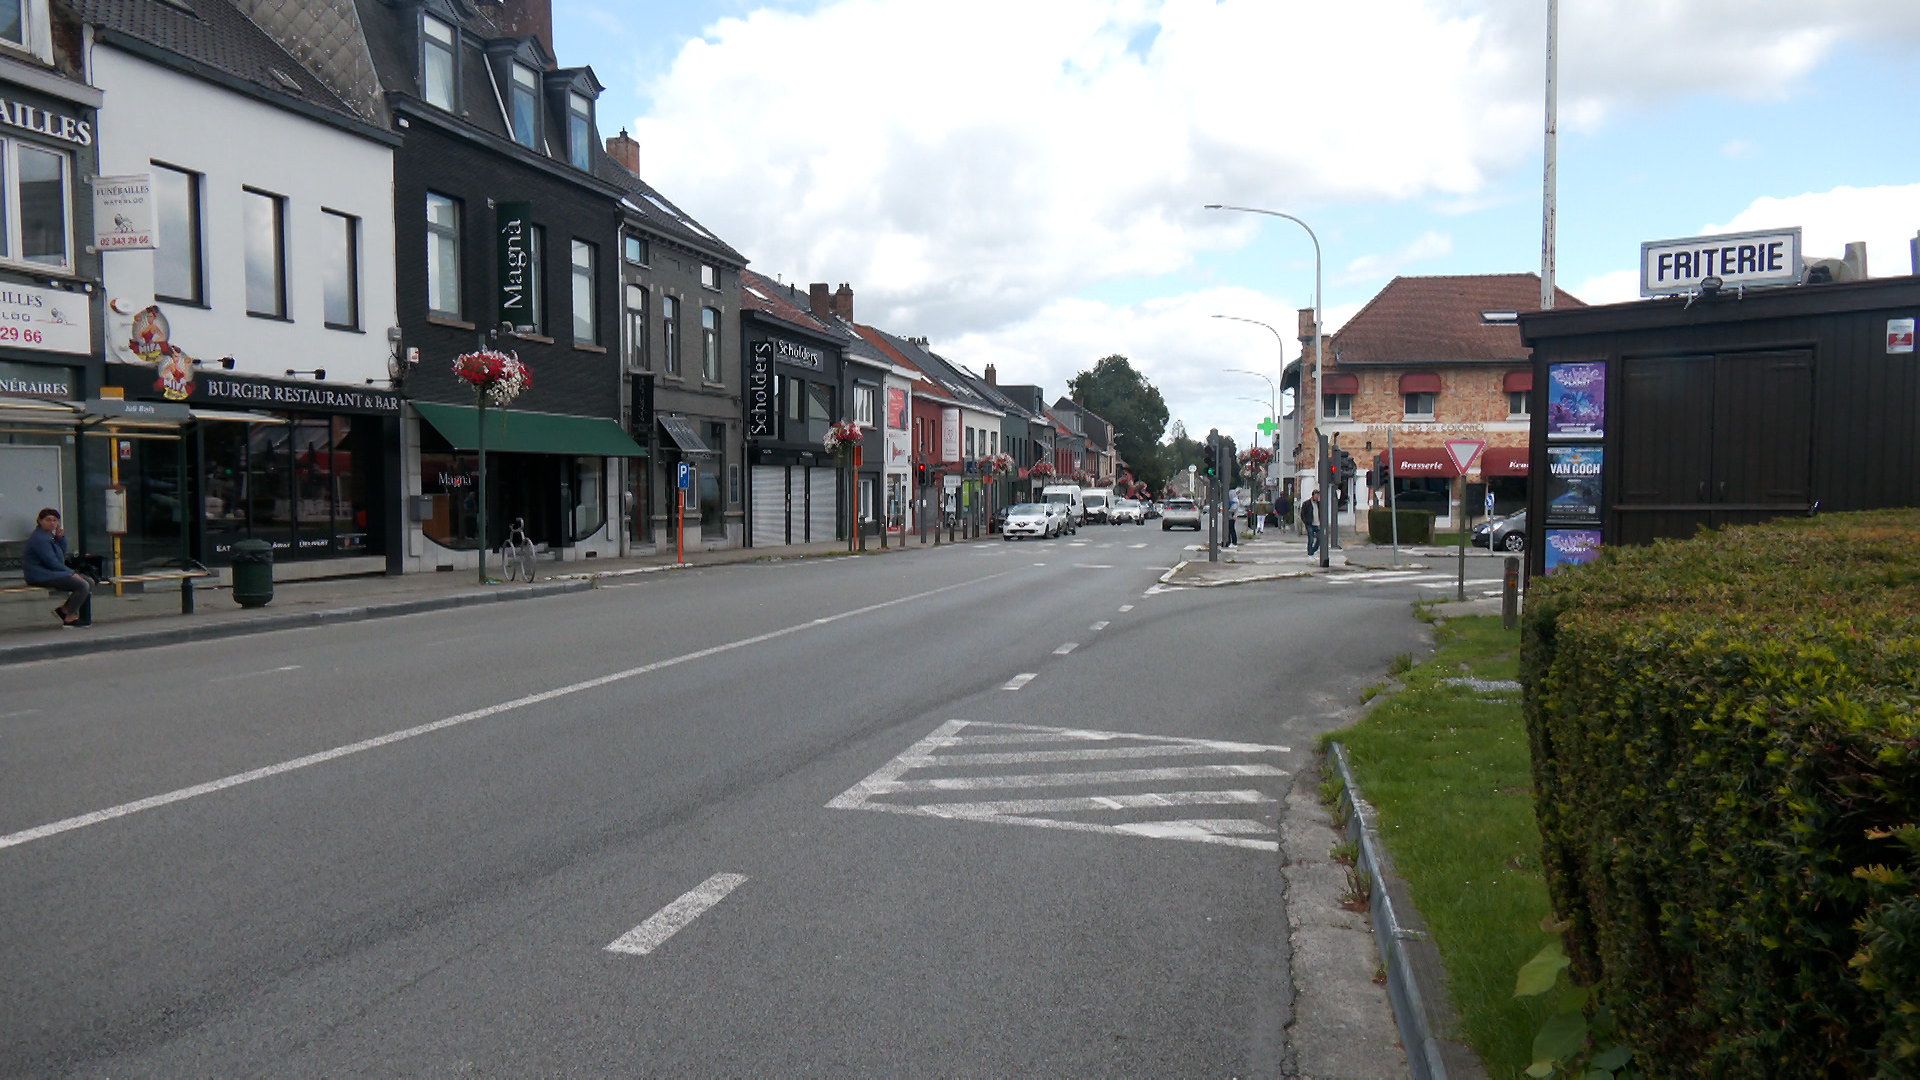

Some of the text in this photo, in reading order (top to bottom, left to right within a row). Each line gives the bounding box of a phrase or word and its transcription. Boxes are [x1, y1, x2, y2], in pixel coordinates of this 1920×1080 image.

[96, 185, 150, 196] FUNÉRAILLES
[104, 197, 144, 205] WATERLOO
[100, 237, 110, 246] 02
[112, 236, 126, 246] 343
[139, 235, 149, 244] 66
[1657, 241, 1784, 282] FRITERIE
[0, 325, 42, 344] 29 66
[778, 339, 818, 366] Scholders
[0, 377, 68, 395] NÉRAIRES
[751, 342, 771, 434] Scholders
[208, 380, 399, 411] BURGER RESTAURANT & BAR
[680, 465, 687, 478] P
[1400, 460, 1443, 470] Brasserie
[1550, 463, 1600, 475] VAN GOGH
